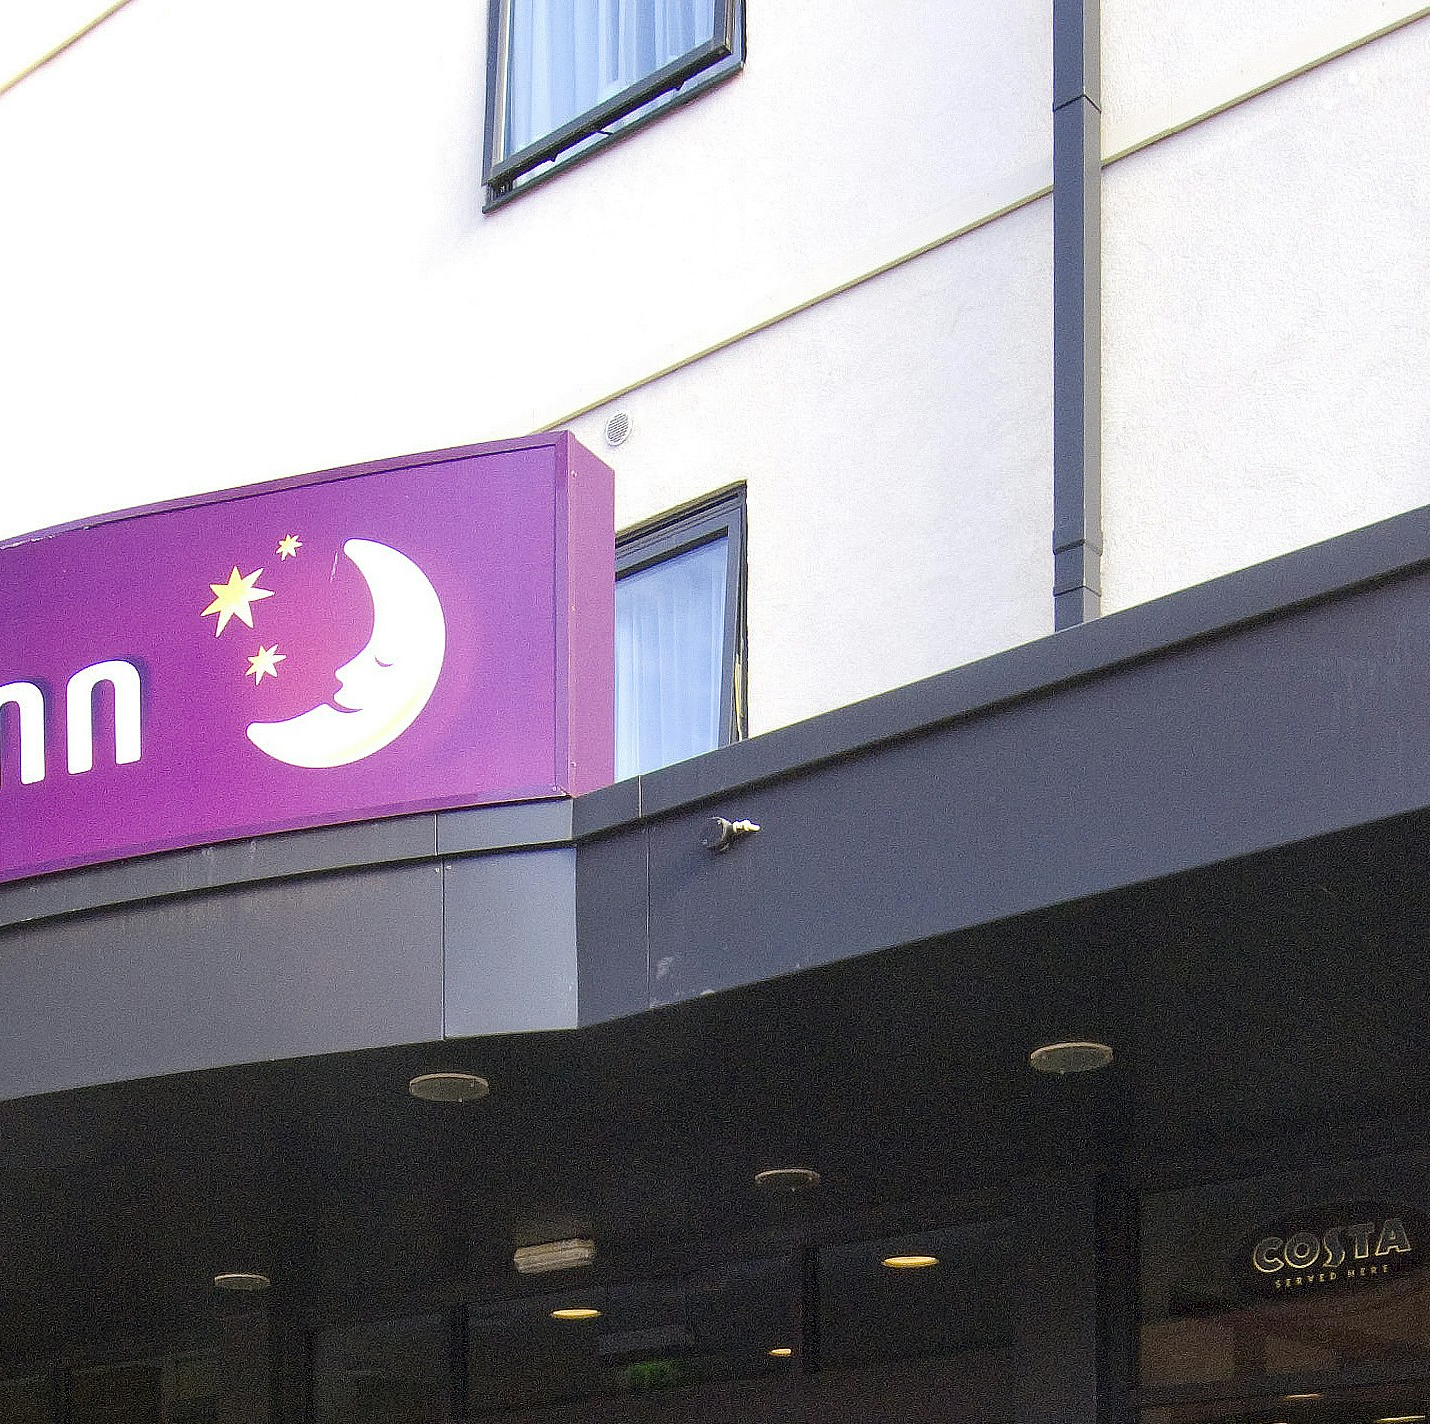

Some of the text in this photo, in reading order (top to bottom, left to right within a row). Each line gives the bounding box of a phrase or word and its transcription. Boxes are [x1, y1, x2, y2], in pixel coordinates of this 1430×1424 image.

[1253, 1217, 1413, 1274] COSTA
[1274, 1264, 1388, 1289] SERVED HERE
